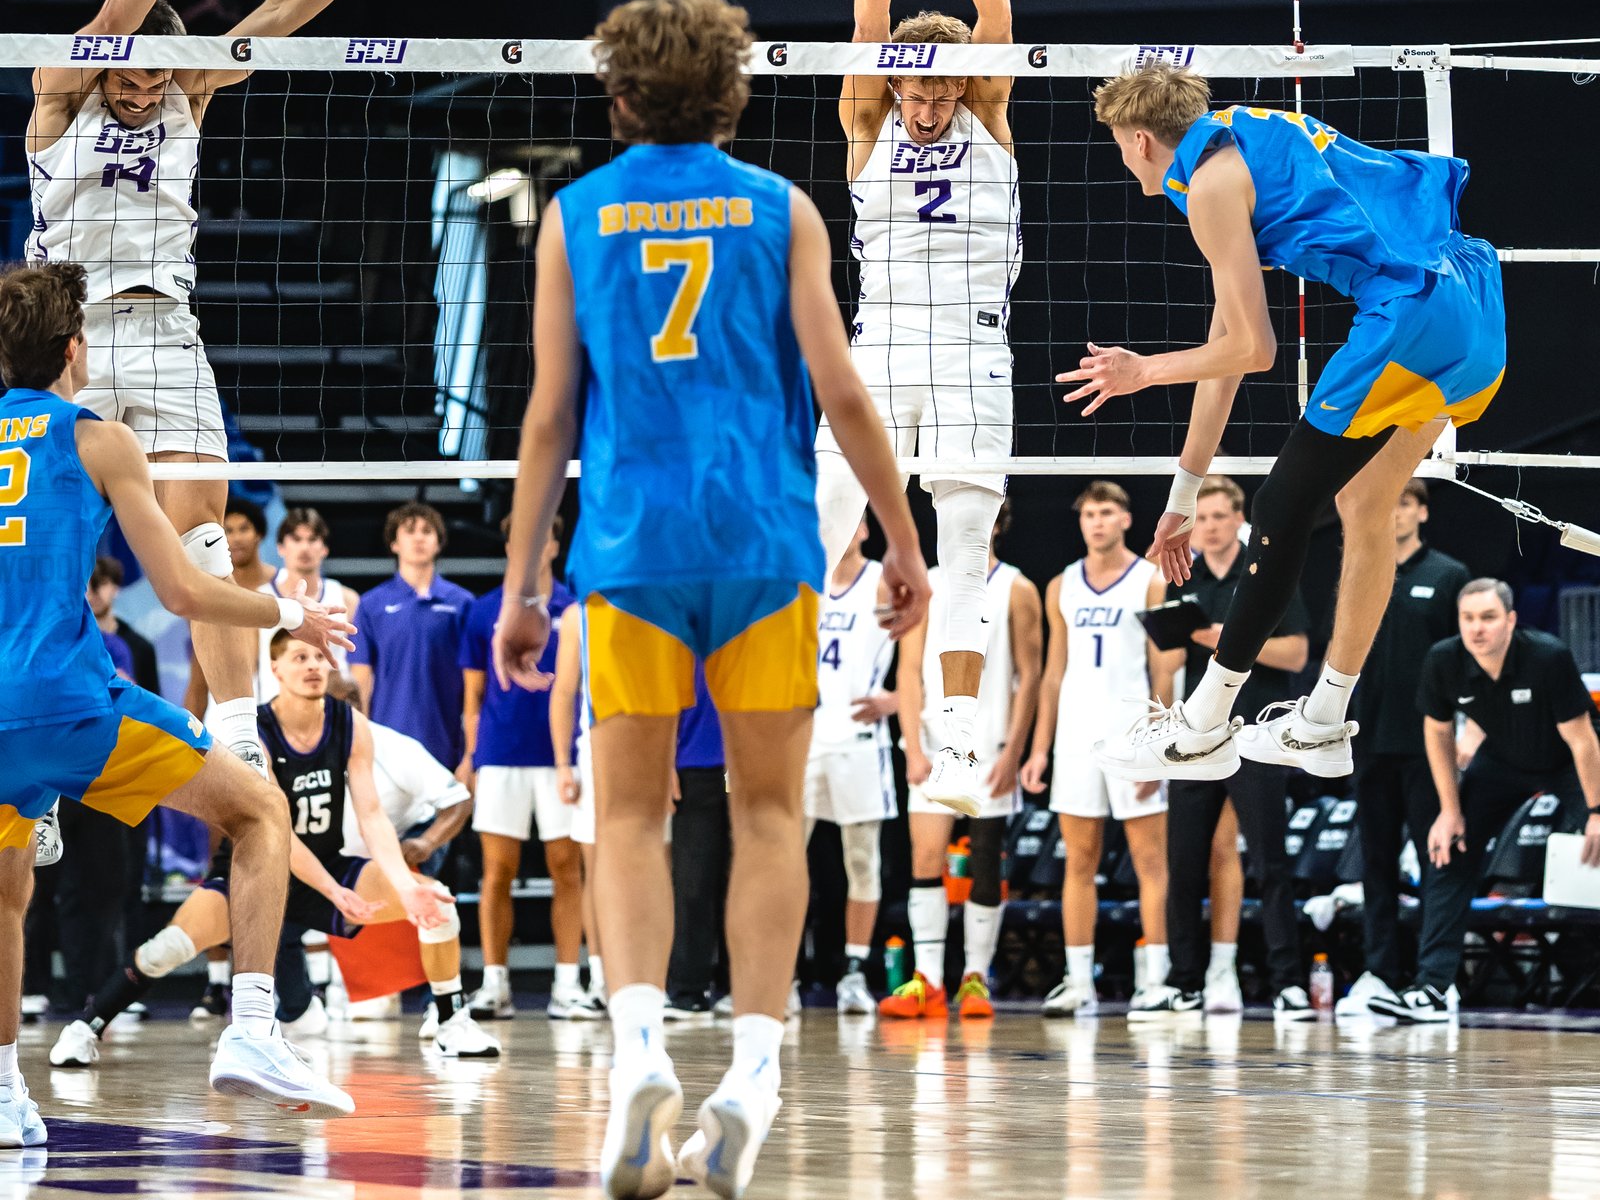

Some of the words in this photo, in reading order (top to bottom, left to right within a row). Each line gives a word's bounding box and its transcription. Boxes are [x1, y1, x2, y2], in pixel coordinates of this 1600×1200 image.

[70, 36, 135, 61] GCU
[230, 38, 252, 62] G
[345, 39, 408, 64] GCU
[501, 41, 523, 64] G
[767, 43, 788, 66] G
[877, 44, 938, 68] GCU
[1028, 46, 1048, 68] G
[94, 122, 166, 154] GCU
[890, 140, 969, 173] GCU
[914, 179, 957, 223] 2
[598, 196, 754, 236] BRUINS
[640, 236, 714, 363] 7
[0, 413, 51, 442] INS
[1074, 607, 1123, 628] GCU
[1092, 633, 1103, 668] 1
[292, 769, 332, 792] GCU
[294, 792, 332, 835] 15
